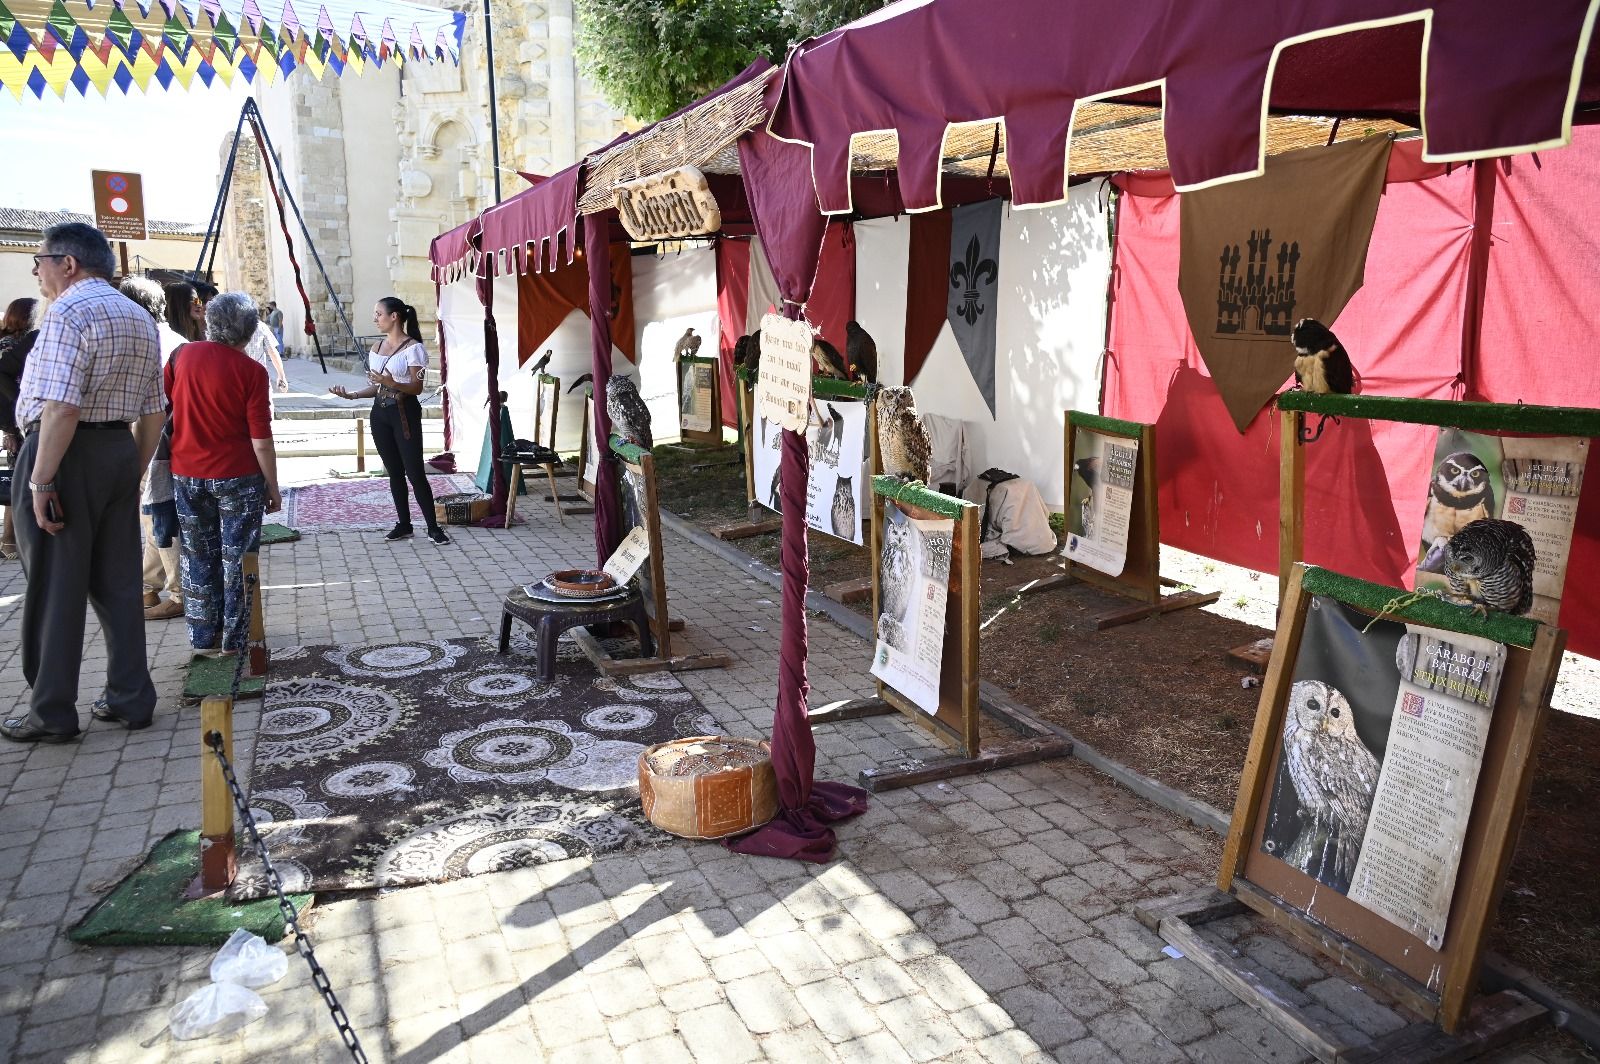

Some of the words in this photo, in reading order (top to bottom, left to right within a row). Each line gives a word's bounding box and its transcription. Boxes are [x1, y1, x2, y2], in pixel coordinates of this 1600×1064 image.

[1528, 464, 1565, 474] LECHUZA
[1532, 474, 1571, 484] ANTEOJOS
[1425, 644, 1475, 665] CÁRABO
[1476, 659, 1490, 672] DE
[1431, 659, 1482, 681] BATARÁZ
[1413, 669, 1448, 686] STRIX
[1448, 680, 1489, 701] RUFIPES
